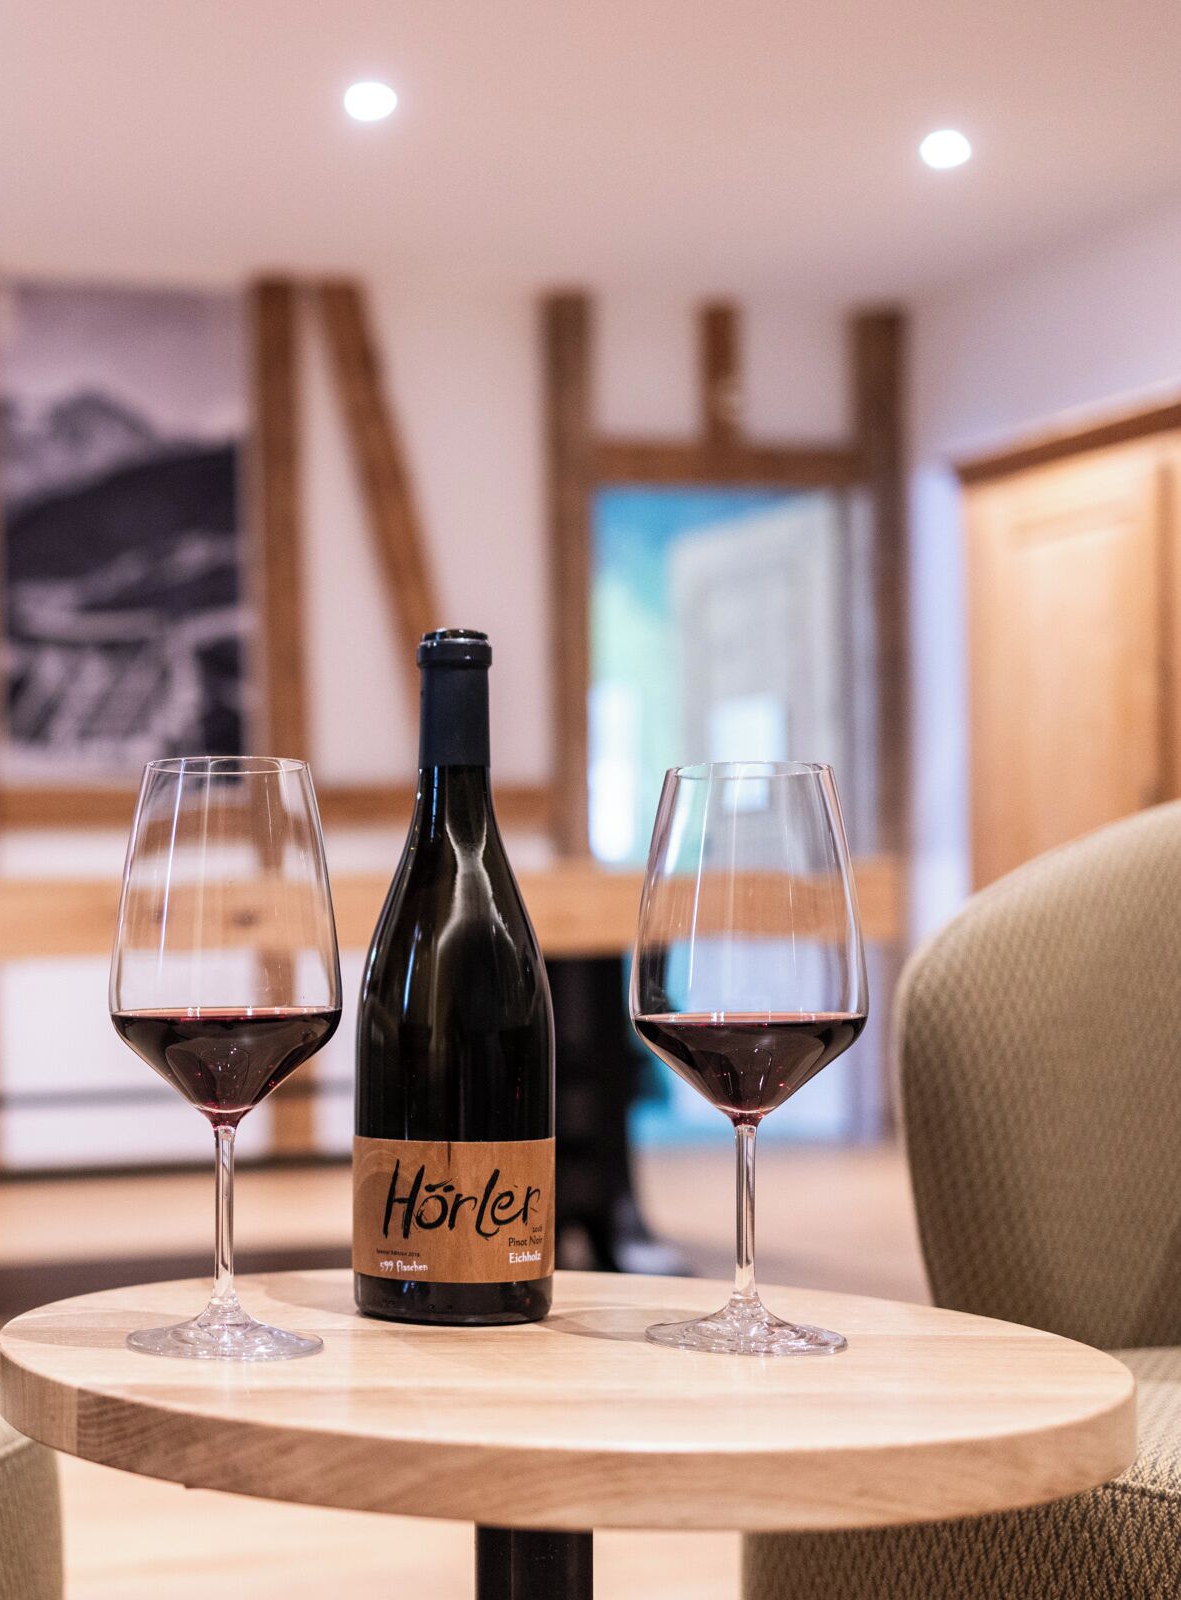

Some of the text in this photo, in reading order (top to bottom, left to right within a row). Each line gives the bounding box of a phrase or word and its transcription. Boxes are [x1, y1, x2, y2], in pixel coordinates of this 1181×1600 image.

[383, 1159, 541, 1240] Hörler
[508, 1234, 543, 1247] Pinot Noir
[509, 1250, 542, 1264] Eichholz
[379, 1260, 394, 1272] 599
